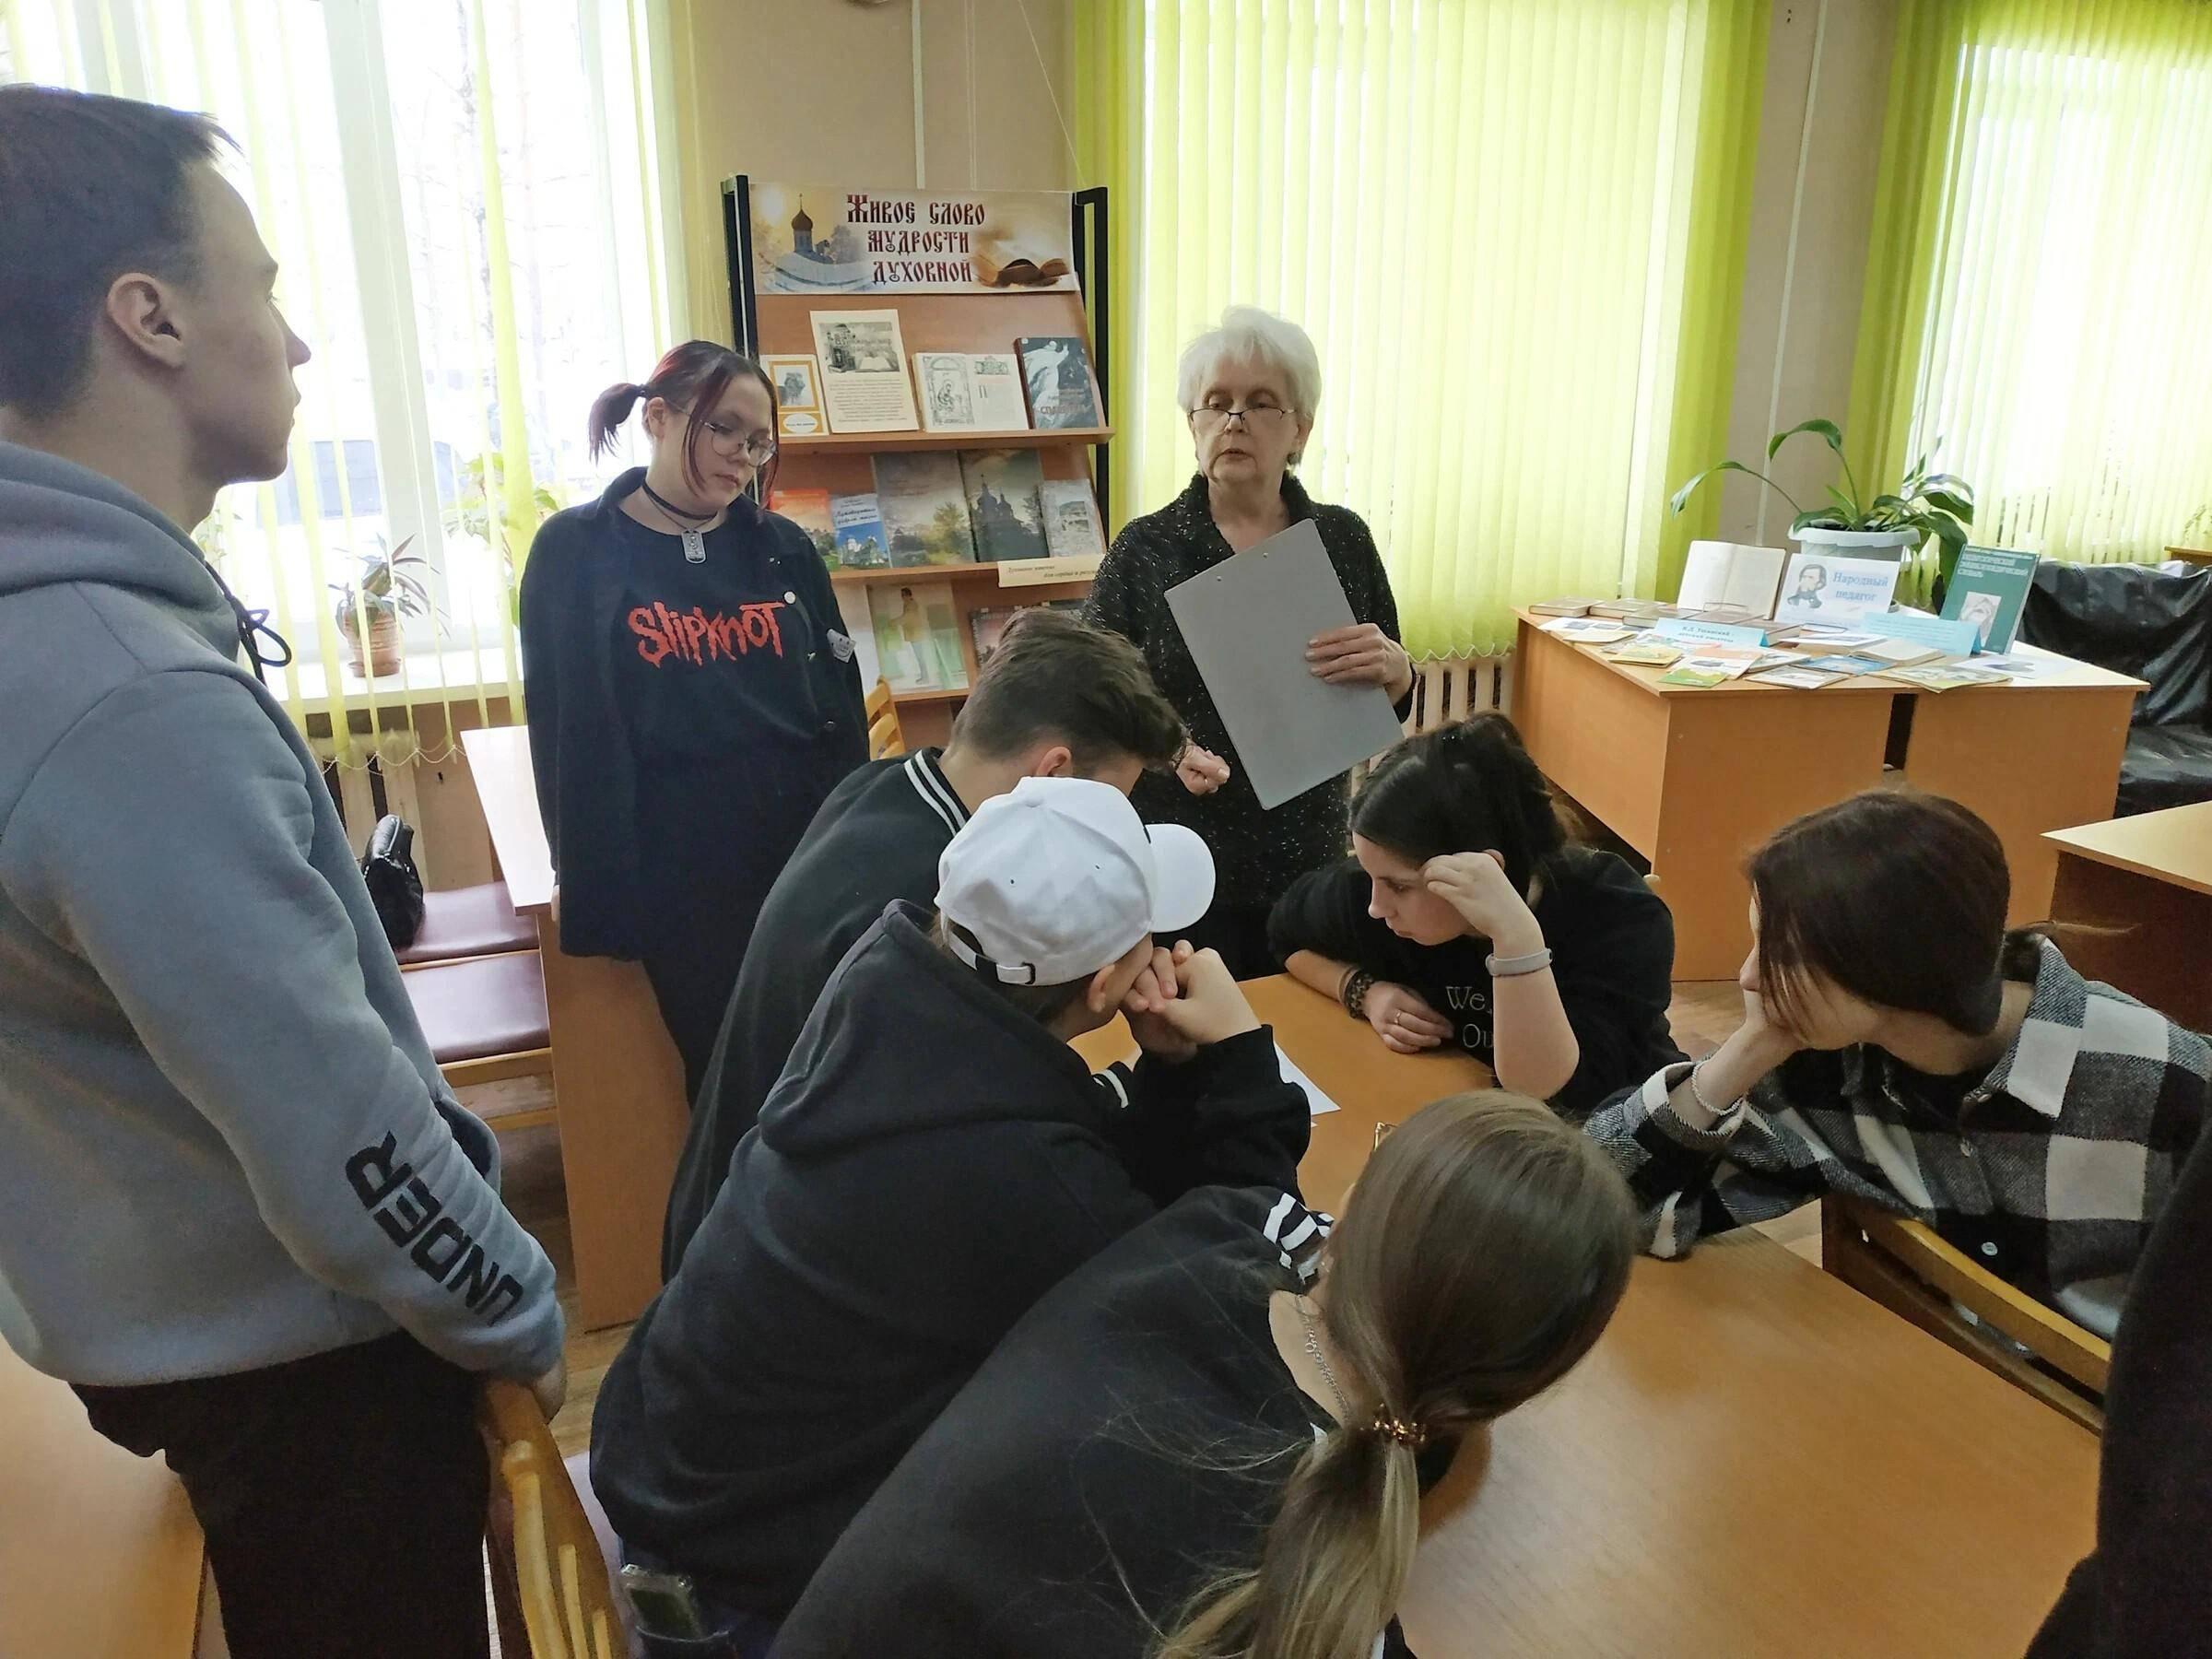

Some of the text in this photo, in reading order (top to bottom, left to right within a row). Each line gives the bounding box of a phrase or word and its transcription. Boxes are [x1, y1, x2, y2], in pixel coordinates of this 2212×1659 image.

[847, 194, 985, 226] Живое слово
[867, 229, 970, 256] мудрости
[873, 259, 972, 286] духовной
[1832, 571, 1889, 588] Народный
[1835, 590, 1878, 602] педагог
[345, 1130, 524, 1327] UNDER
